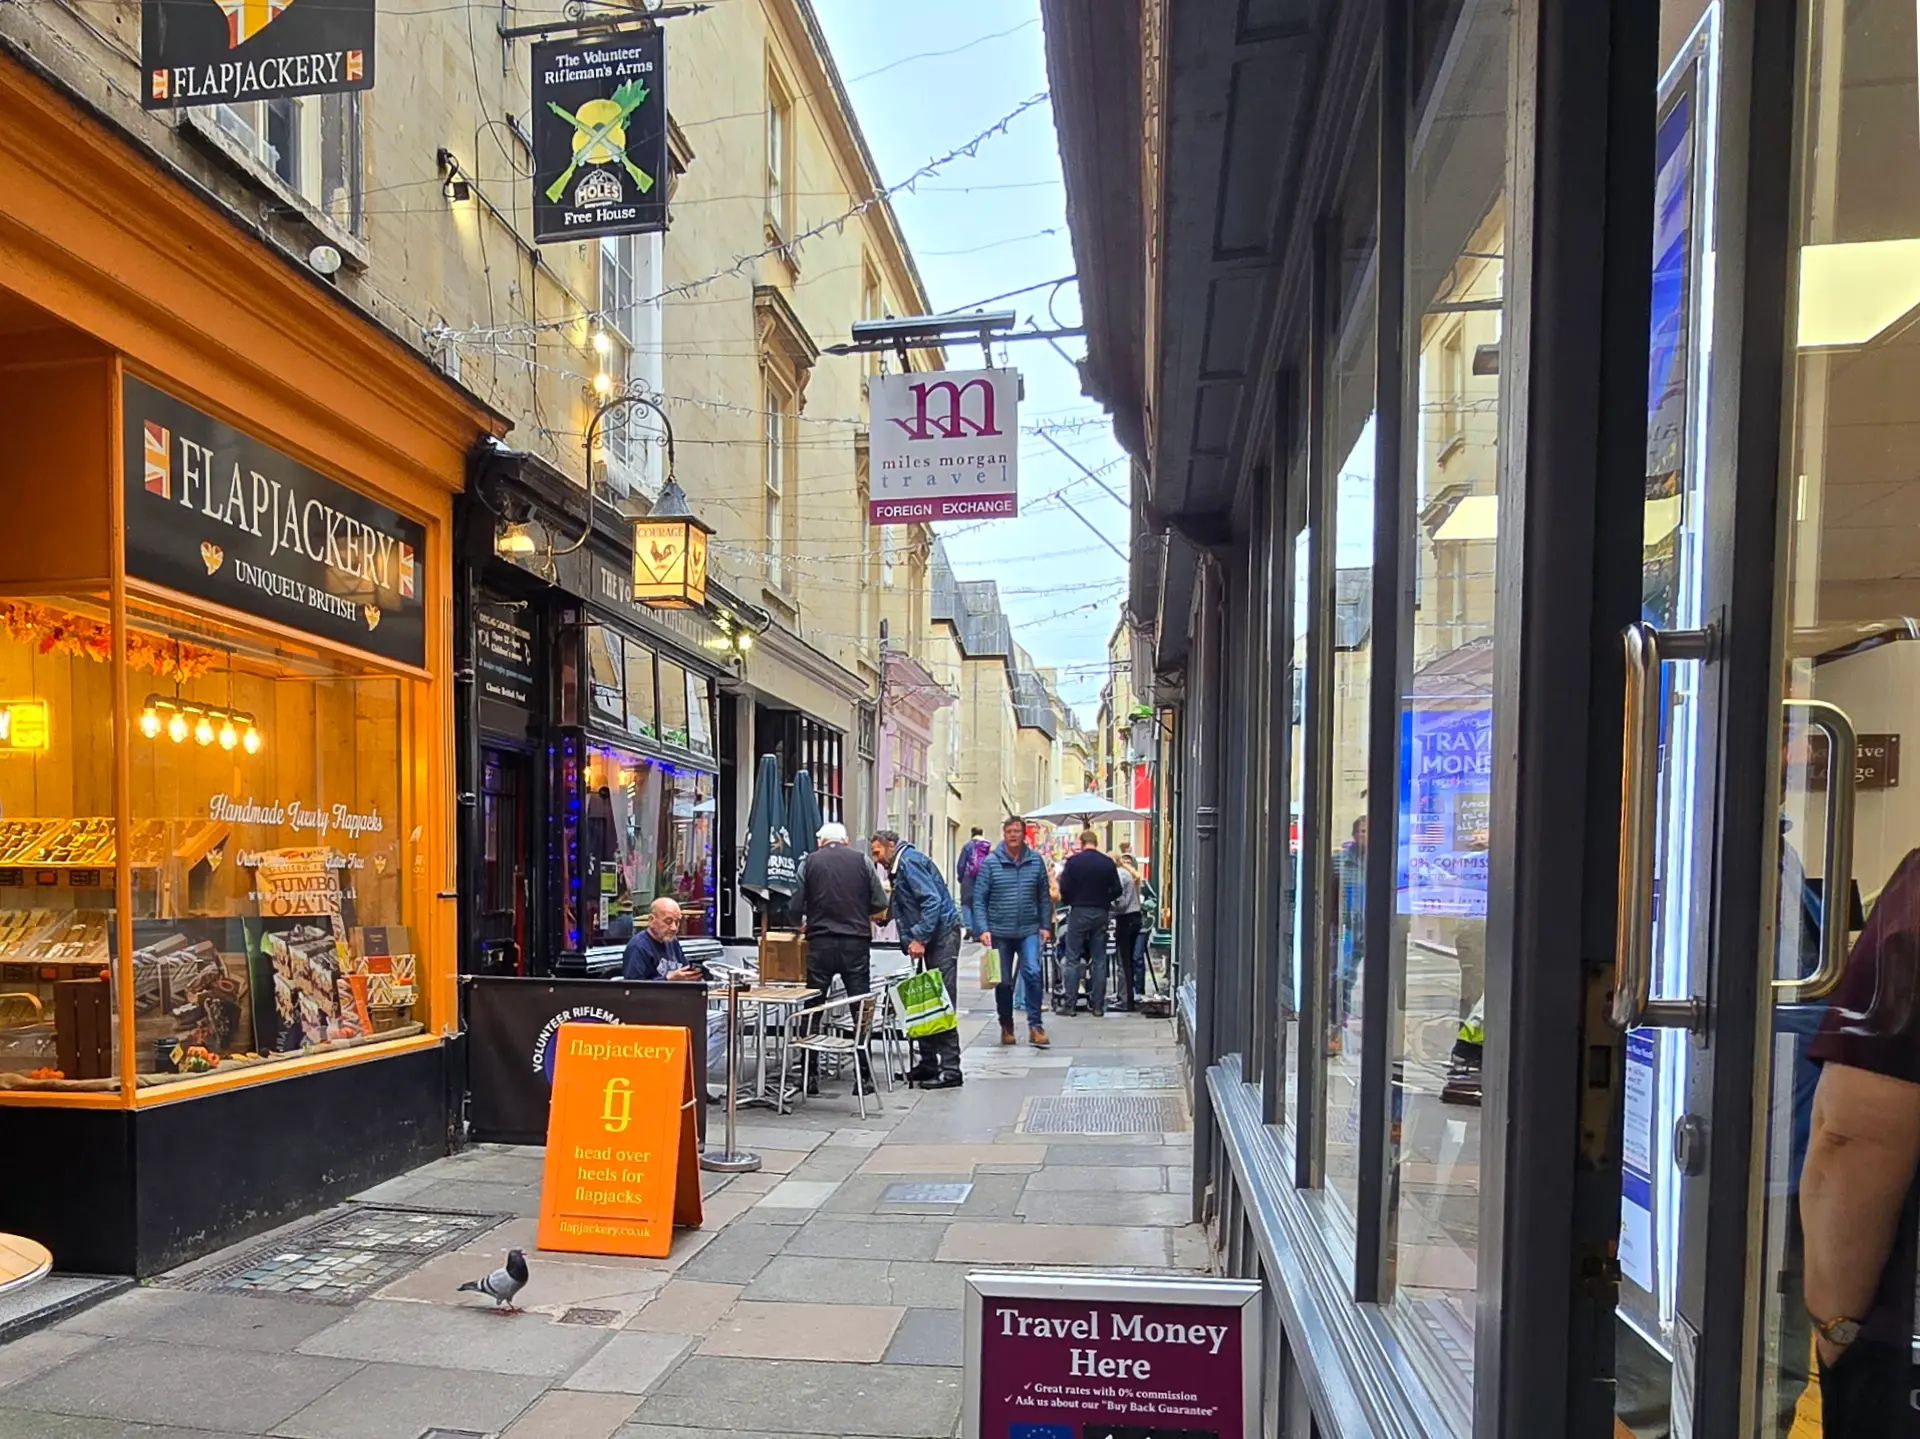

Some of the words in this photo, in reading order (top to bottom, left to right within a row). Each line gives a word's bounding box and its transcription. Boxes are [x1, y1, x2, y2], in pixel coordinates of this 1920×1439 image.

[556, 54, 580, 68] The
[583, 48, 642, 65] Volunteer
[172, 52, 342, 98] FLAPJACKERY
[544, 65, 612, 85] Rifleman's
[616, 60, 654, 75] Arms
[579, 183, 619, 202] MOLES
[564, 211, 592, 225] Free
[596, 208, 636, 222] House
[882, 455, 931, 470] miles
[939, 453, 1007, 469] morgan
[882, 465, 1007, 488] travel
[179, 436, 396, 590] FLAPJACKERY
[876, 504, 932, 518] FOREIGN
[942, 500, 1013, 514] EXCHANGE
[637, 527, 684, 537] COURAGE
[234, 559, 306, 603] UNIQUELY
[308, 587, 357, 621] BRITISH
[601, 567, 618, 601] THE
[1419, 731, 1492, 752] TRAV
[1422, 754, 1491, 774] MONE
[209, 793, 285, 824] Handmade
[287, 801, 329, 836] Luxury
[270, 876, 337, 895] JUMBO
[271, 893, 341, 916] OATS
[532, 1010, 572, 1073] VOLUNTEER
[572, 1006, 626, 1026] RIFLEMA
[569, 1039, 677, 1062] flapjackery
[574, 1146, 611, 1162] head
[616, 1149, 652, 1163] over
[577, 1166, 617, 1183] heels
[621, 1167, 645, 1184] for
[575, 1186, 643, 1206] flapjacks
[559, 1221, 651, 1238] flapjackery.co.uk
[996, 1308, 1100, 1341] Travel
[1110, 1313, 1228, 1355] Money
[1069, 1348, 1151, 1380] Here
[1034, 1382, 1063, 1394] Great
[1065, 1385, 1091, 1396] rates
[1093, 1386, 1116, 1397] with
[1118, 1387, 1134, 1398] 0%
[1136, 1389, 1198, 1402] commission
[1015, 1395, 1035, 1406] Ask
[1037, 1398, 1049, 1407] us
[1050, 1398, 1079, 1409] about
[1081, 1400, 1099, 1410] our
[1101, 1400, 1128, 1413] "Buy
[1130, 1401, 1156, 1413] Back
[1158, 1404, 1219, 1417] Guarantee"
